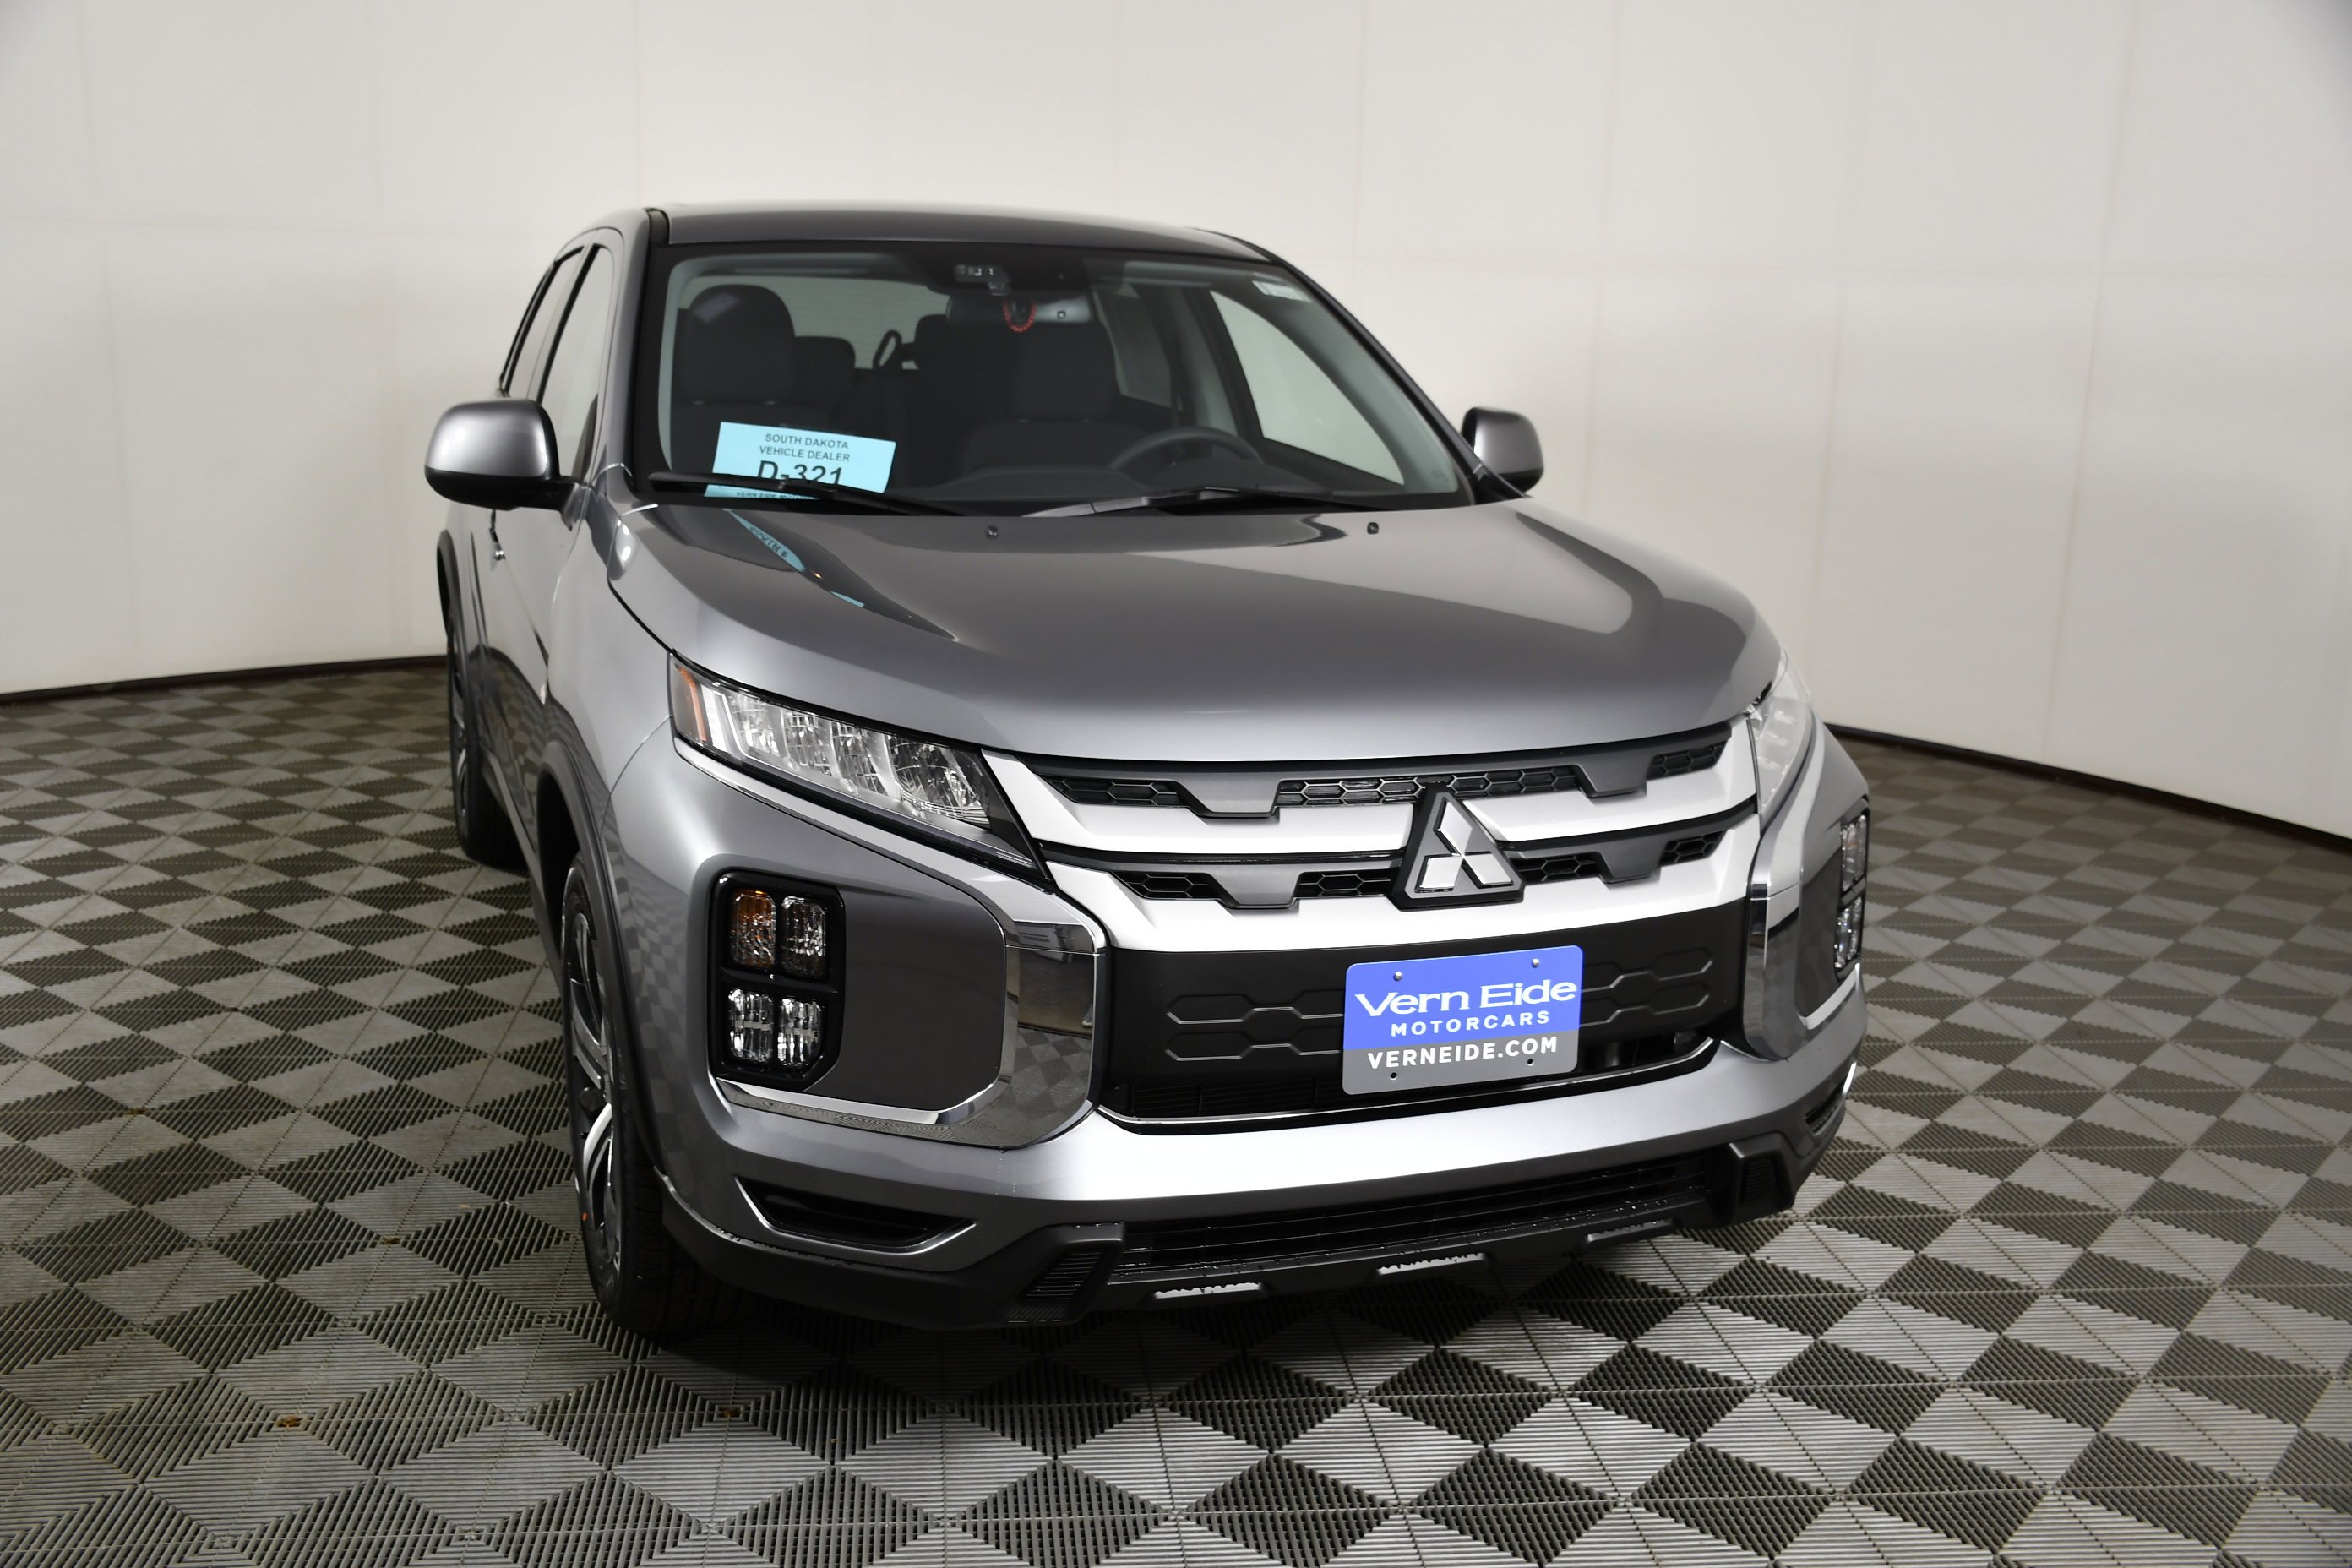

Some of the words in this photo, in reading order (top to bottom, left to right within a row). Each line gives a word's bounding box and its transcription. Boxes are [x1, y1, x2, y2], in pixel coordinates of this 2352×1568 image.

[760, 446, 803, 458] VEHICLE
[808, 449, 850, 461] DEALER
[765, 433, 802, 445] SOUTH
[805, 437, 848, 449] DAKOTA
[757, 460, 843, 485] D-321
[1354, 992, 1469, 1017] Vern
[1479, 979, 1578, 1008] Eide
[1391, 1010, 1549, 1037] MOTORCARS
[1367, 1036, 1557, 1069] VERNEIDE.COM
